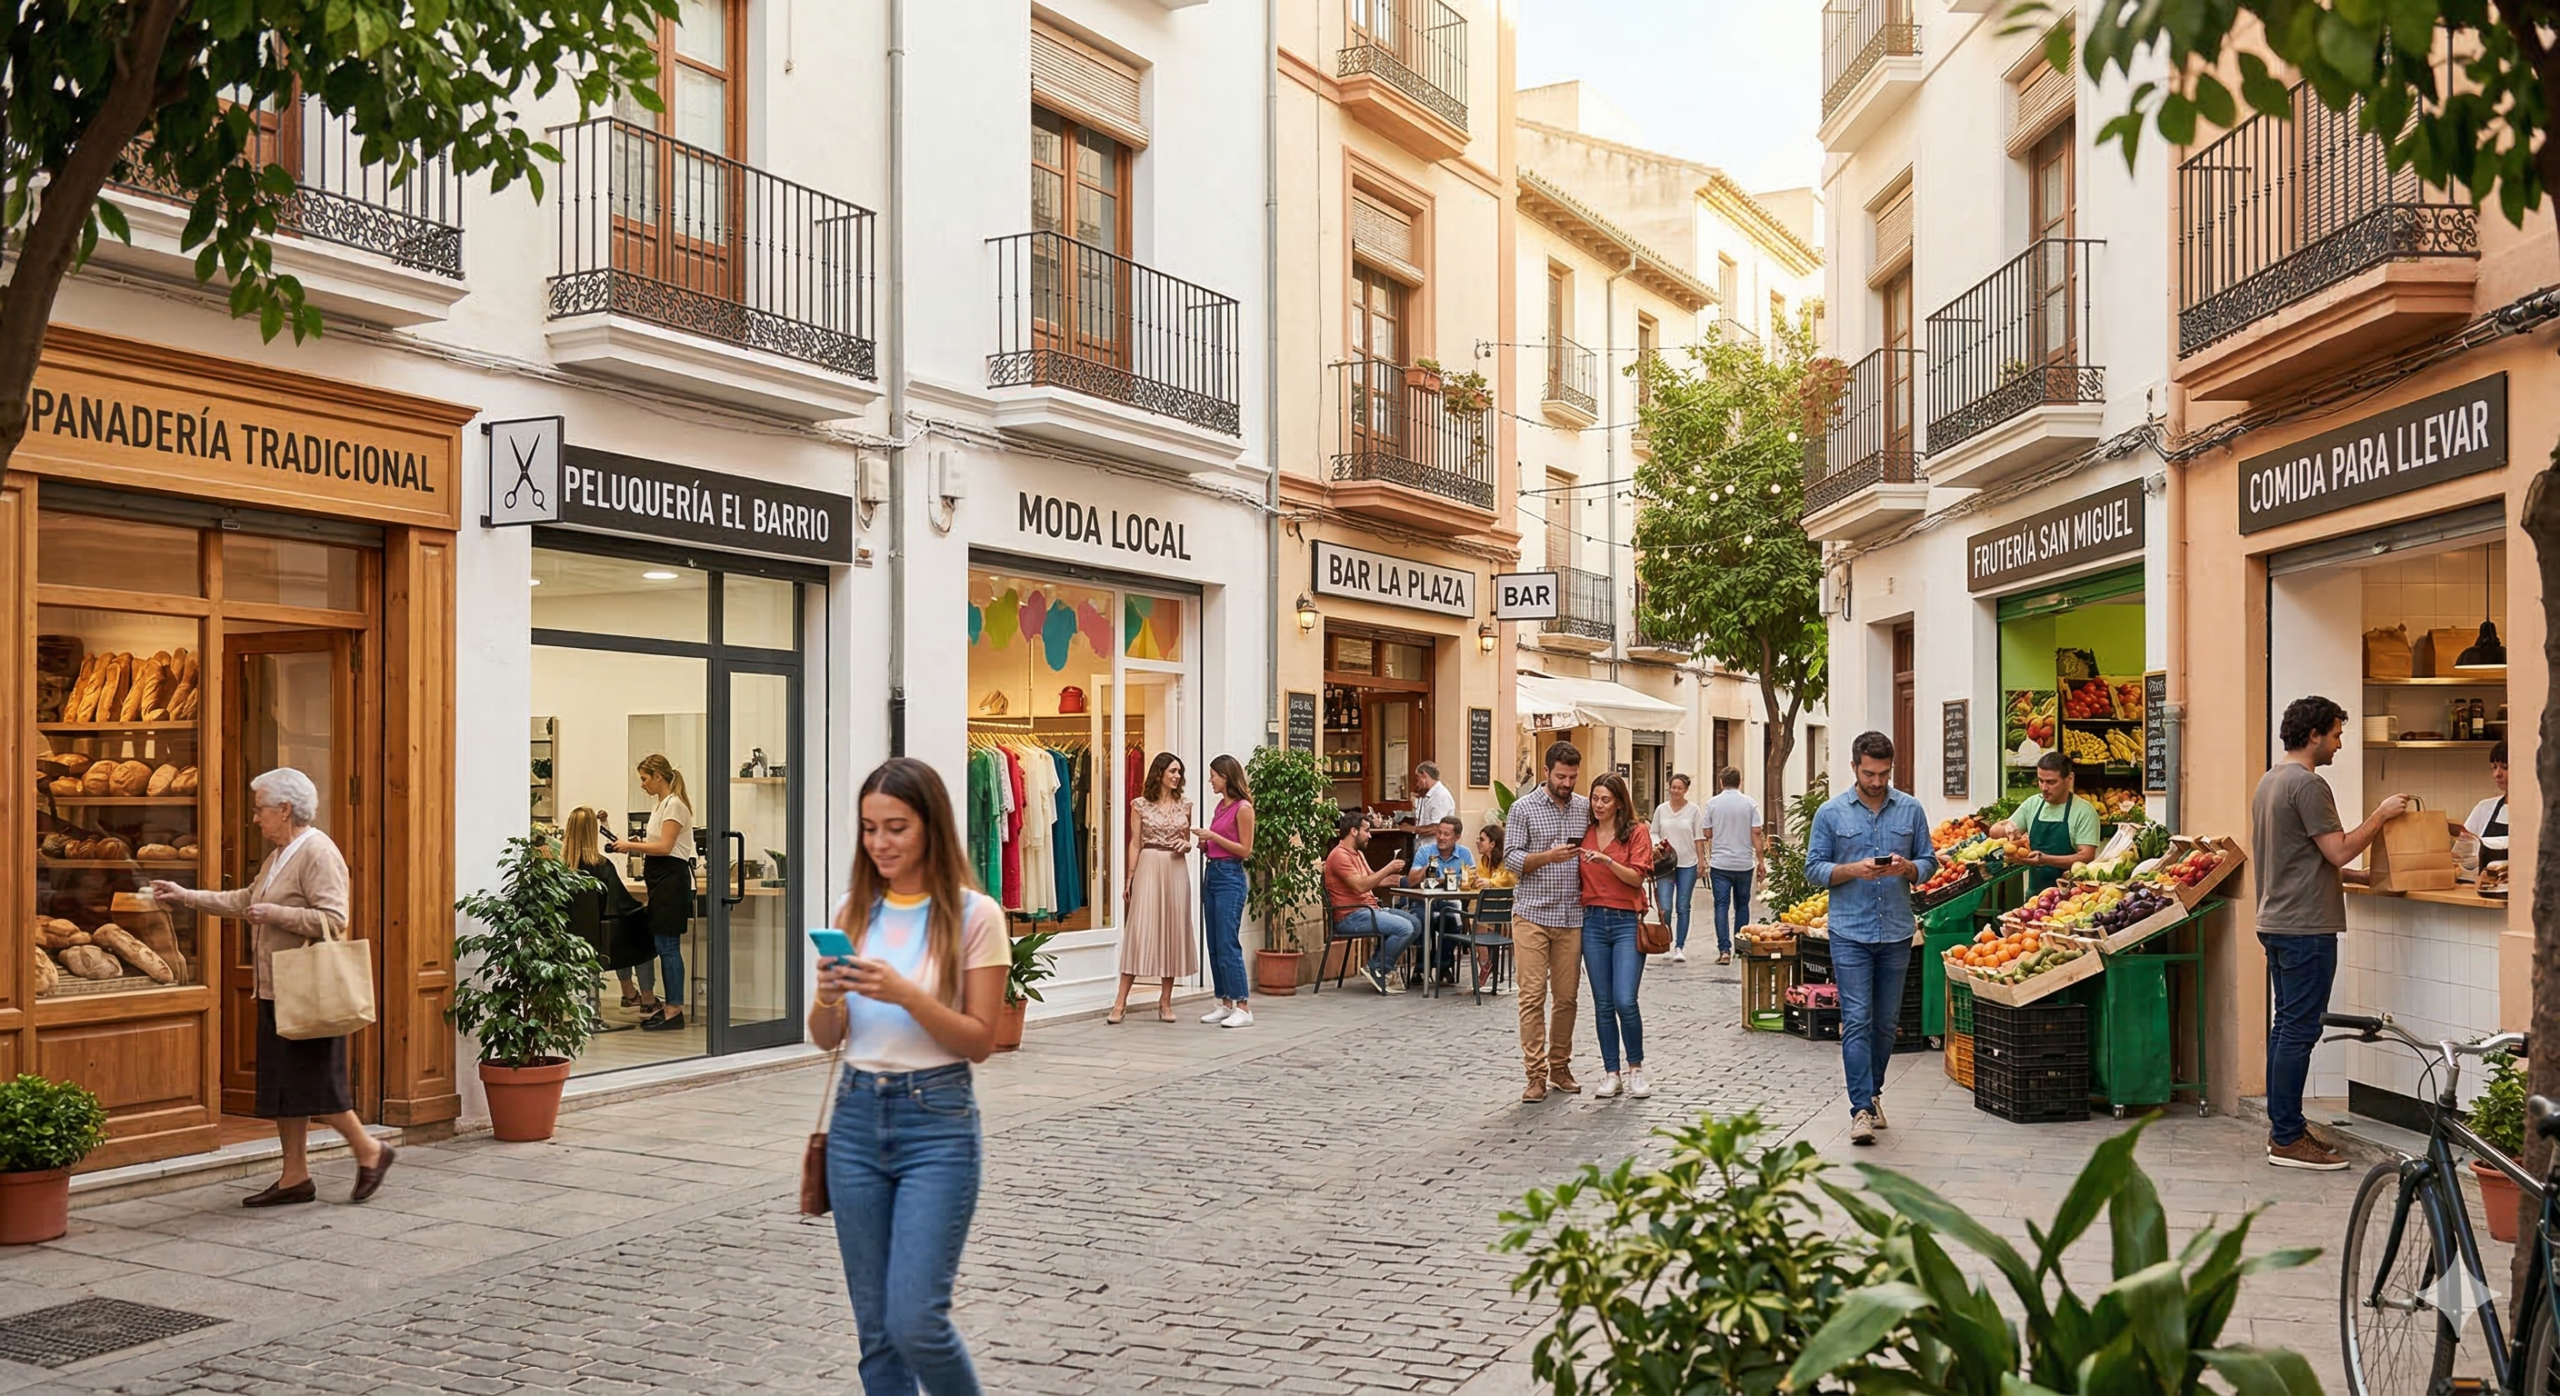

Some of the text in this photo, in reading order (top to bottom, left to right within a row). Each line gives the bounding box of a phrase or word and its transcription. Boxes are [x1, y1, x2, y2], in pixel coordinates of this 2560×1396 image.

[33, 388, 434, 493] PANADERÍA TRADICIONAL
[2249, 400, 2489, 514] COMIDA PARA LLEVAR
[565, 465, 829, 543] PELUQUERÍA EL BARRIO
[1019, 491, 1192, 561] MODA LOCAL
[1974, 497, 2133, 579] FRUTERÍA SAN MIGUEL
[1329, 553, 1465, 608] BAR LA PLAZA
[1504, 585, 1551, 607] BAR
